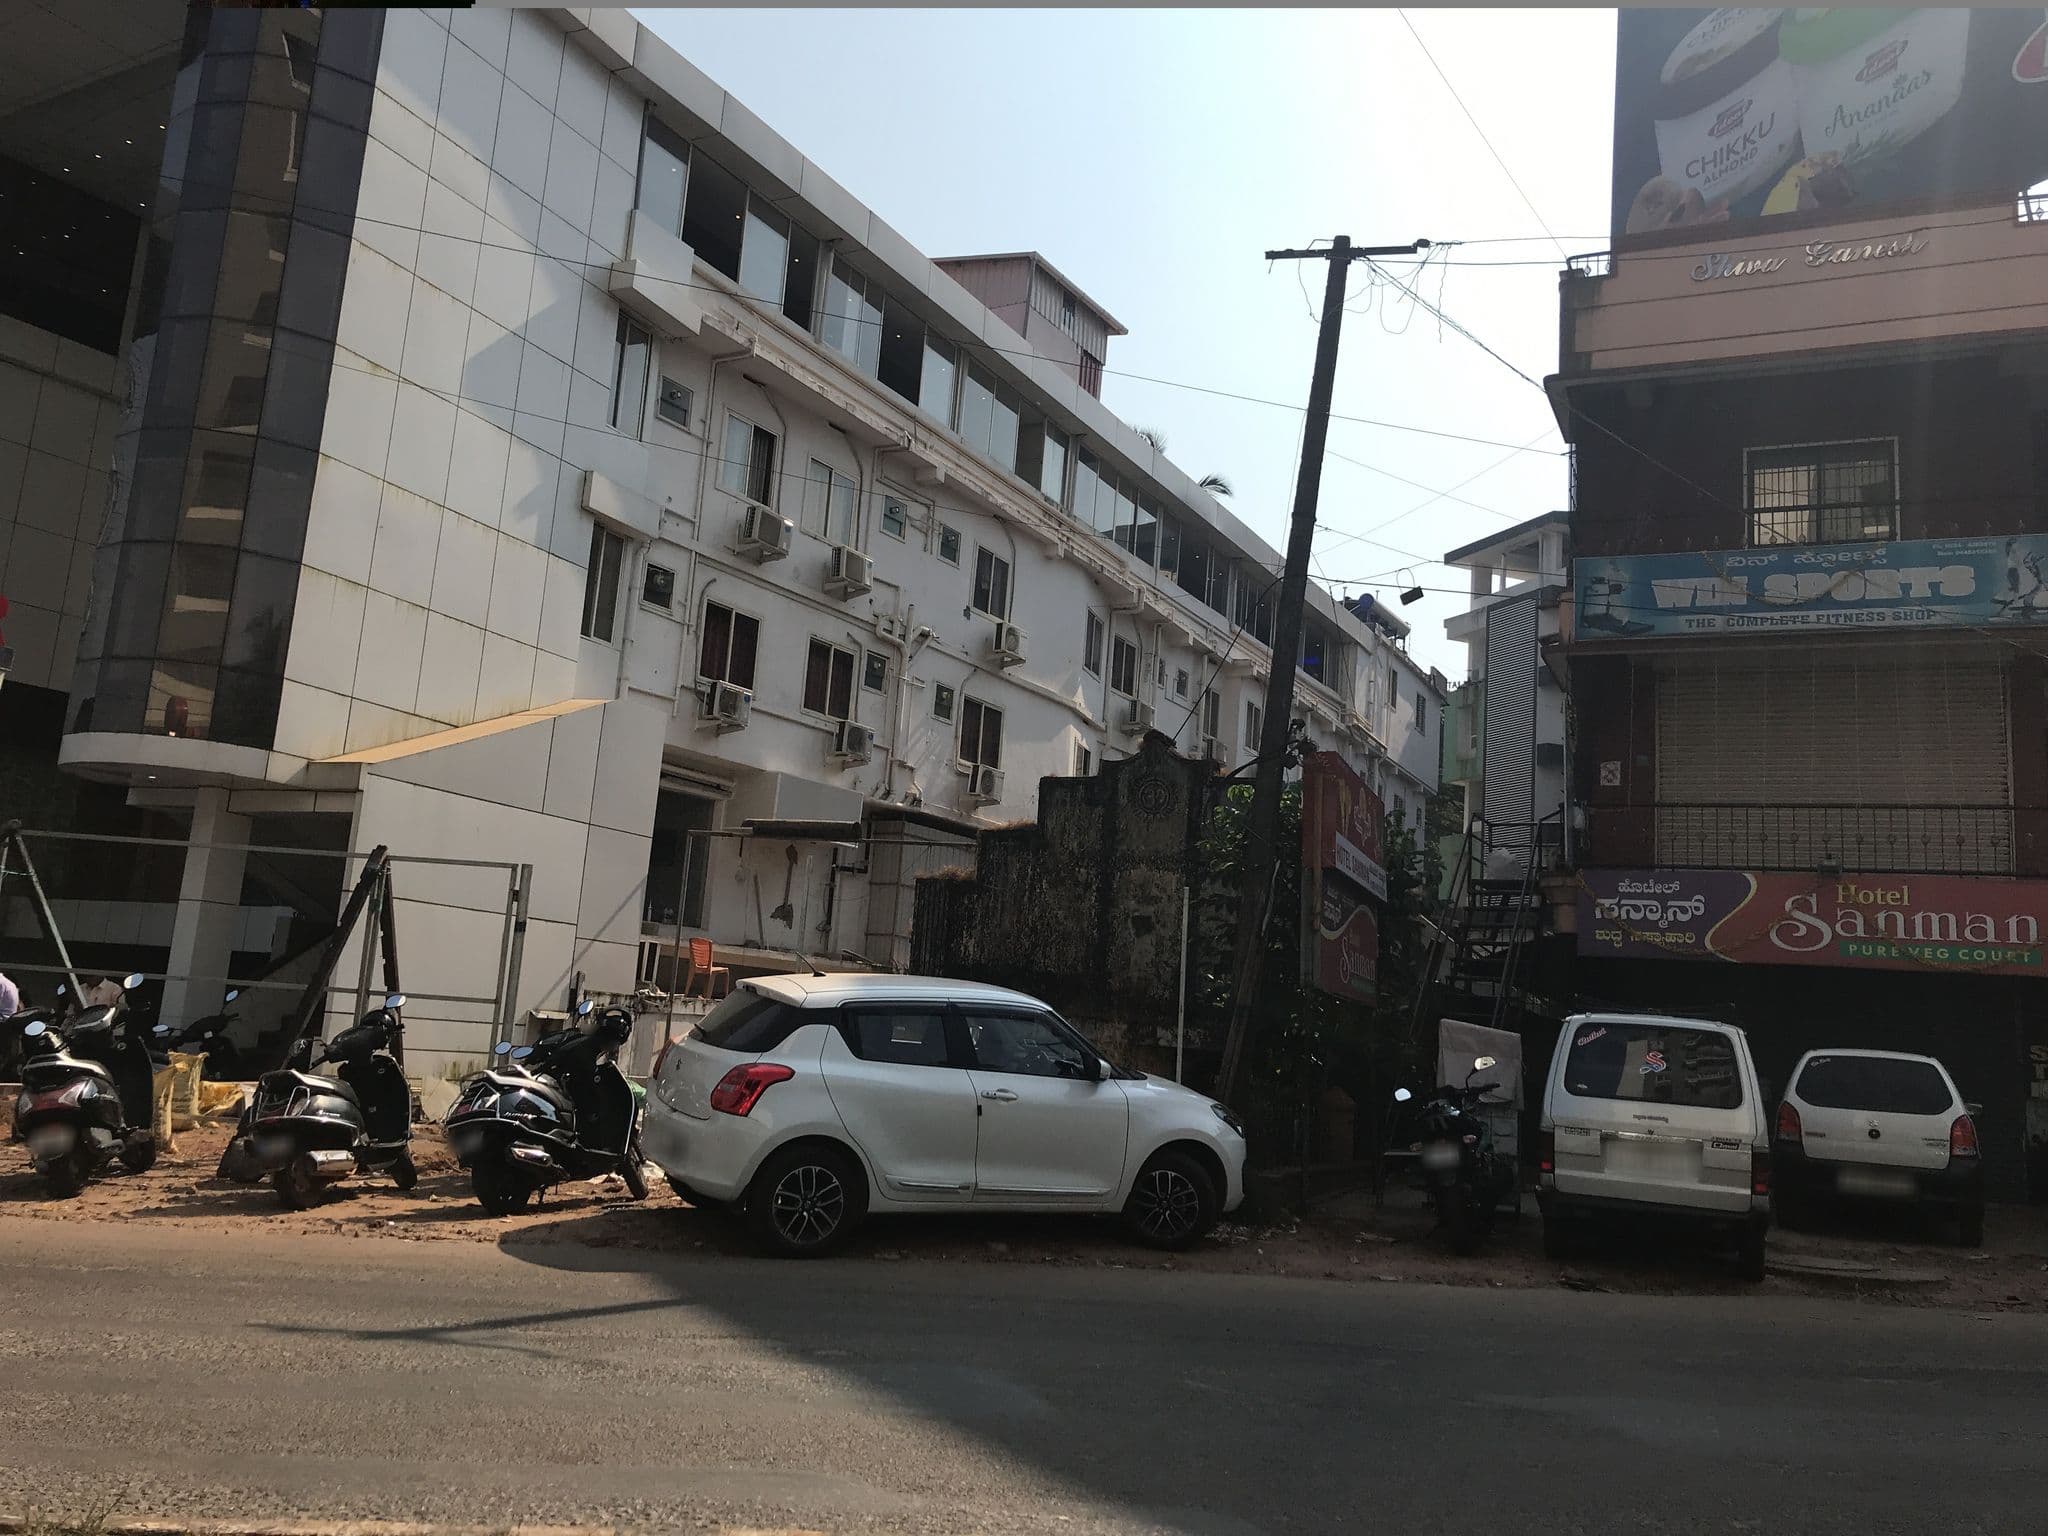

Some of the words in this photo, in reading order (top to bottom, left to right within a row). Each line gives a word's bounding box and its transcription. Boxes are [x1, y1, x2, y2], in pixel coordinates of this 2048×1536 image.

[1685, 112, 1776, 179] CHIKKU
[1702, 146, 1759, 187] ALMOND
[1690, 253, 1788, 281] Shiva
[1803, 234, 1930, 267] Ganesh
[1651, 576, 1748, 608] WIN
[1763, 565, 1976, 604] SPORTS
[1685, 617, 1716, 629] THE
[1726, 614, 1812, 628] COMPLETE
[1816, 611, 1887, 625] FITNESS
[1891, 609, 1937, 623] SHOP
[1594, 894, 1706, 929] ಸನ್ಮಾನ್
[1836, 884, 1911, 906] Hotel
[1769, 892, 2045, 953] Sanman
